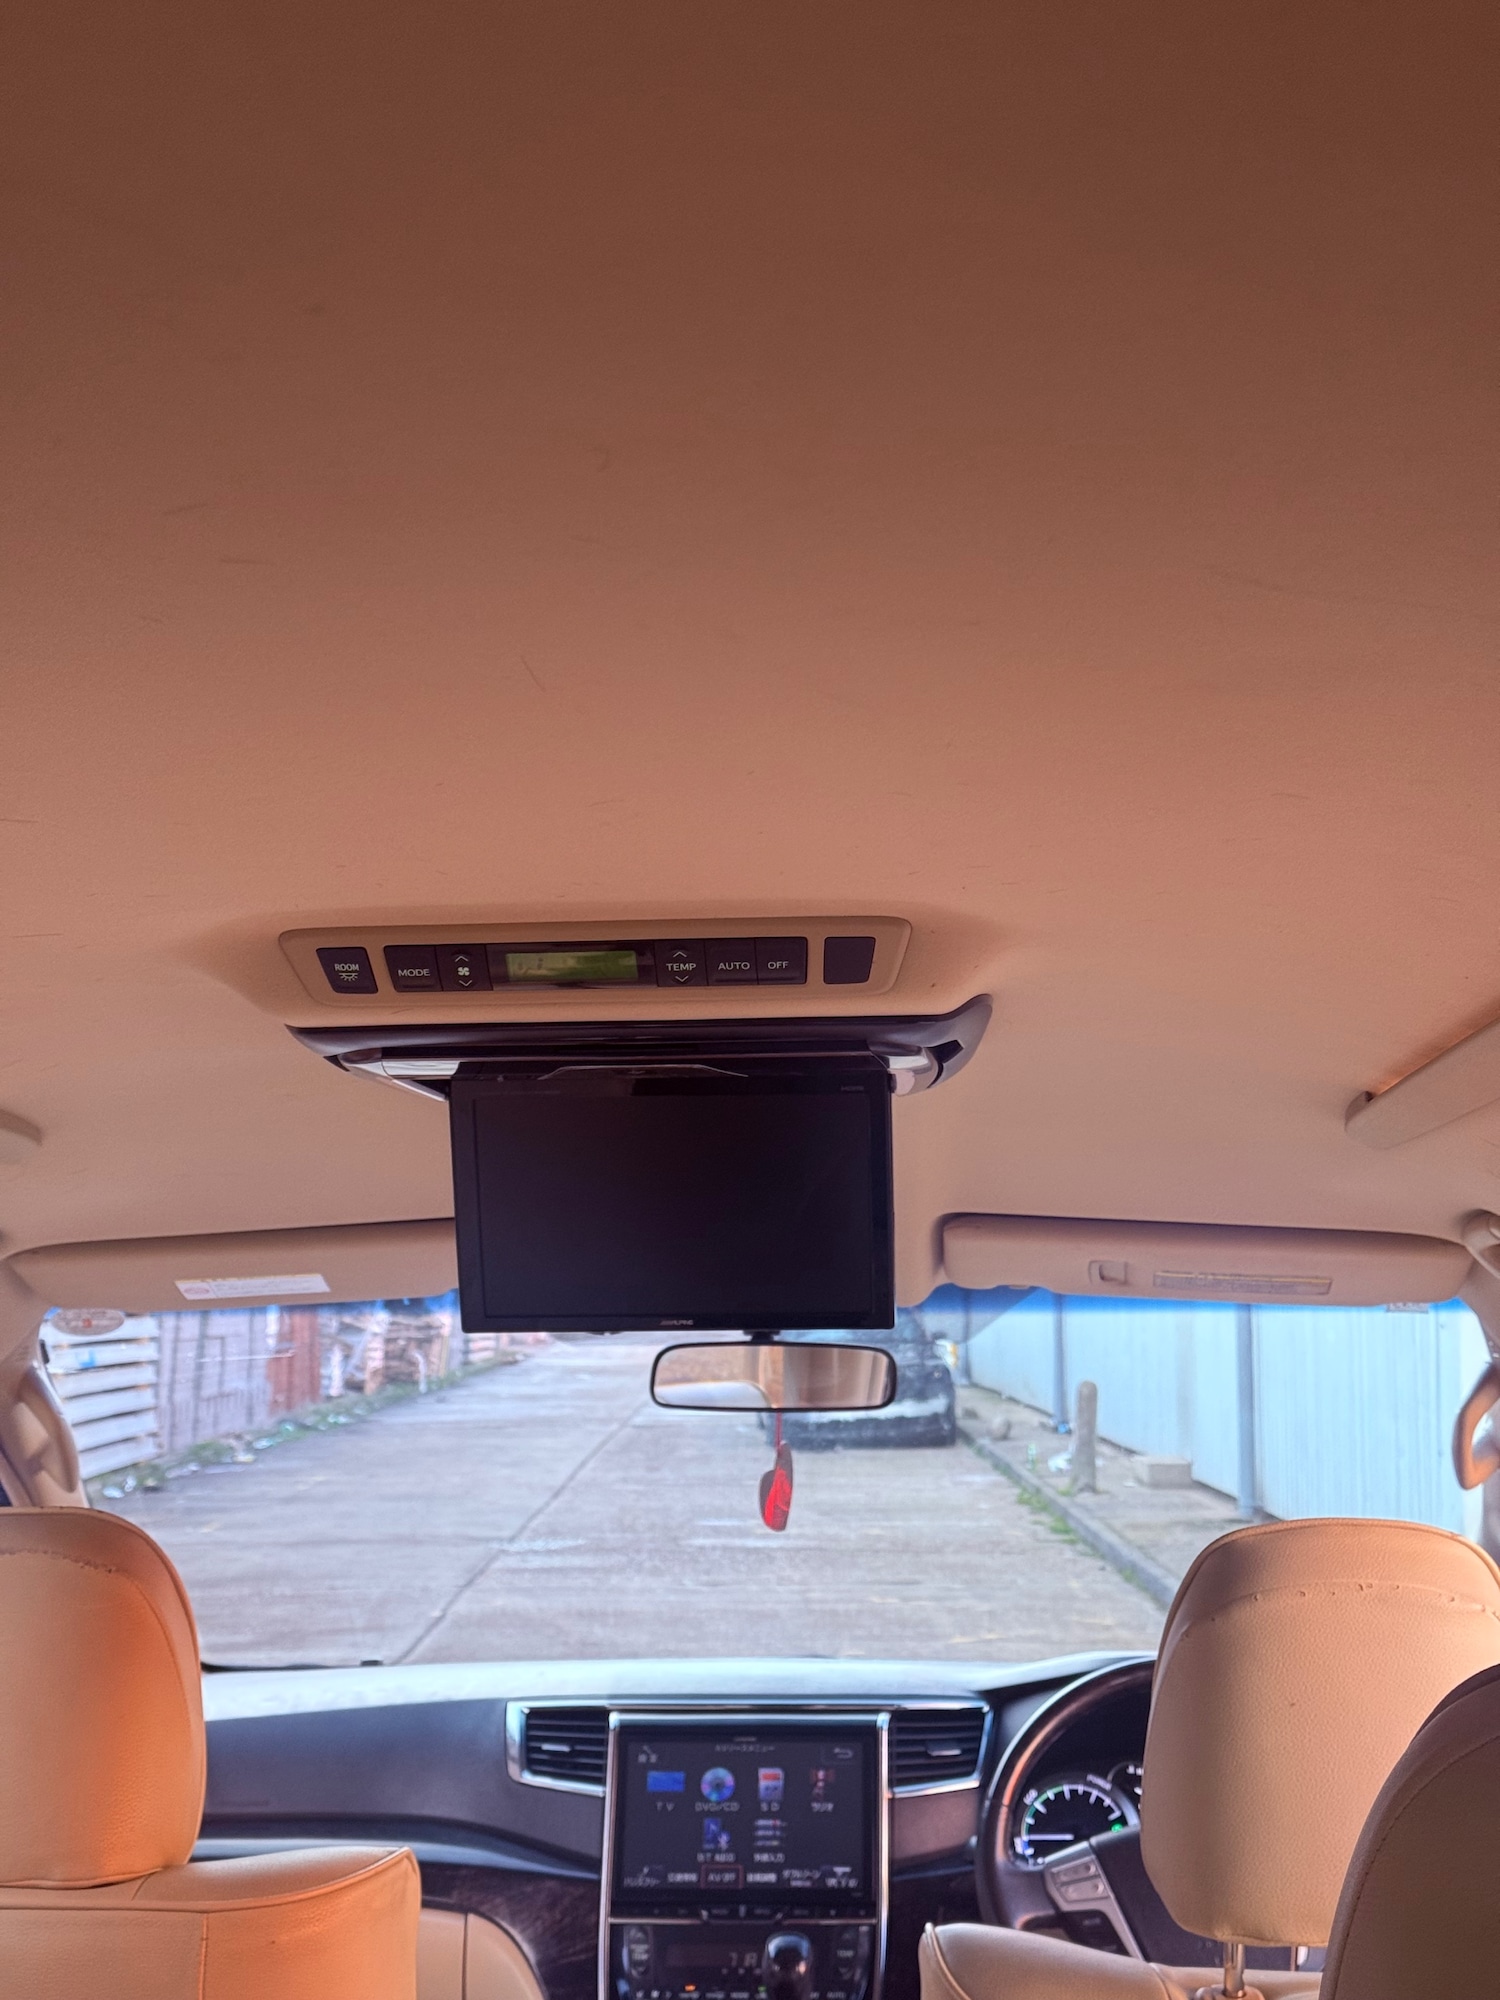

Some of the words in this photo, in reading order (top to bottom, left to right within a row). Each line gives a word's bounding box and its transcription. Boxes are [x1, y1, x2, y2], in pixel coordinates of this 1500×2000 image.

[334, 963, 360, 972] ROOM
[666, 962, 697, 972] TEMP
[718, 961, 751, 971] AUTO
[767, 960, 789, 970] OFF
[397, 967, 431, 977] MODE
